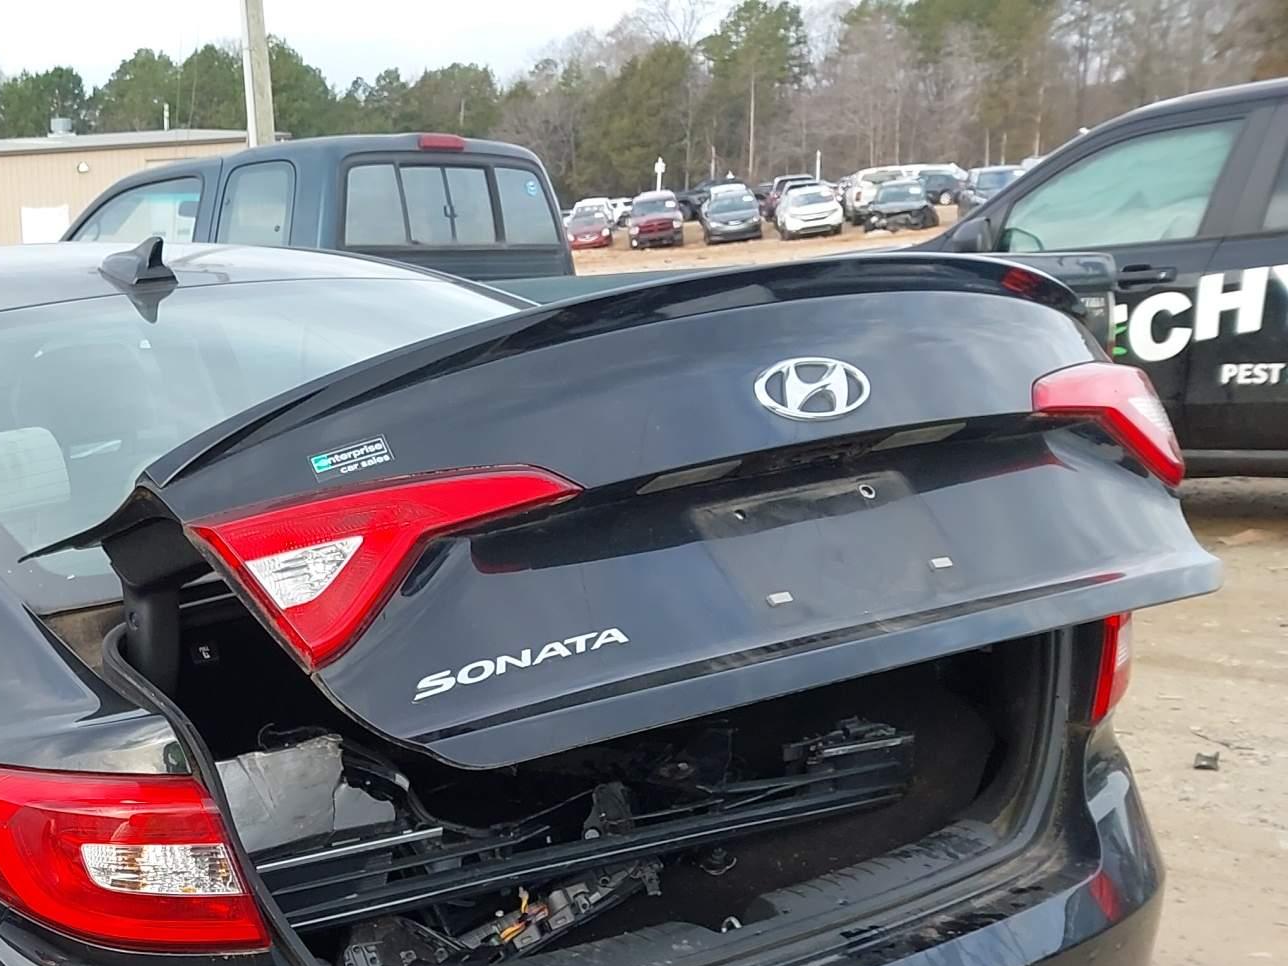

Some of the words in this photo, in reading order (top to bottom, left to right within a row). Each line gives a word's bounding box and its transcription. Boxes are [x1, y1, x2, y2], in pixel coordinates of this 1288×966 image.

[1220, 362, 1286, 385] PEST
[315, 442, 383, 467] enterprise
[340, 463, 359, 475] car
[360, 454, 391, 468] sales
[412, 627, 630, 704] SONATA
